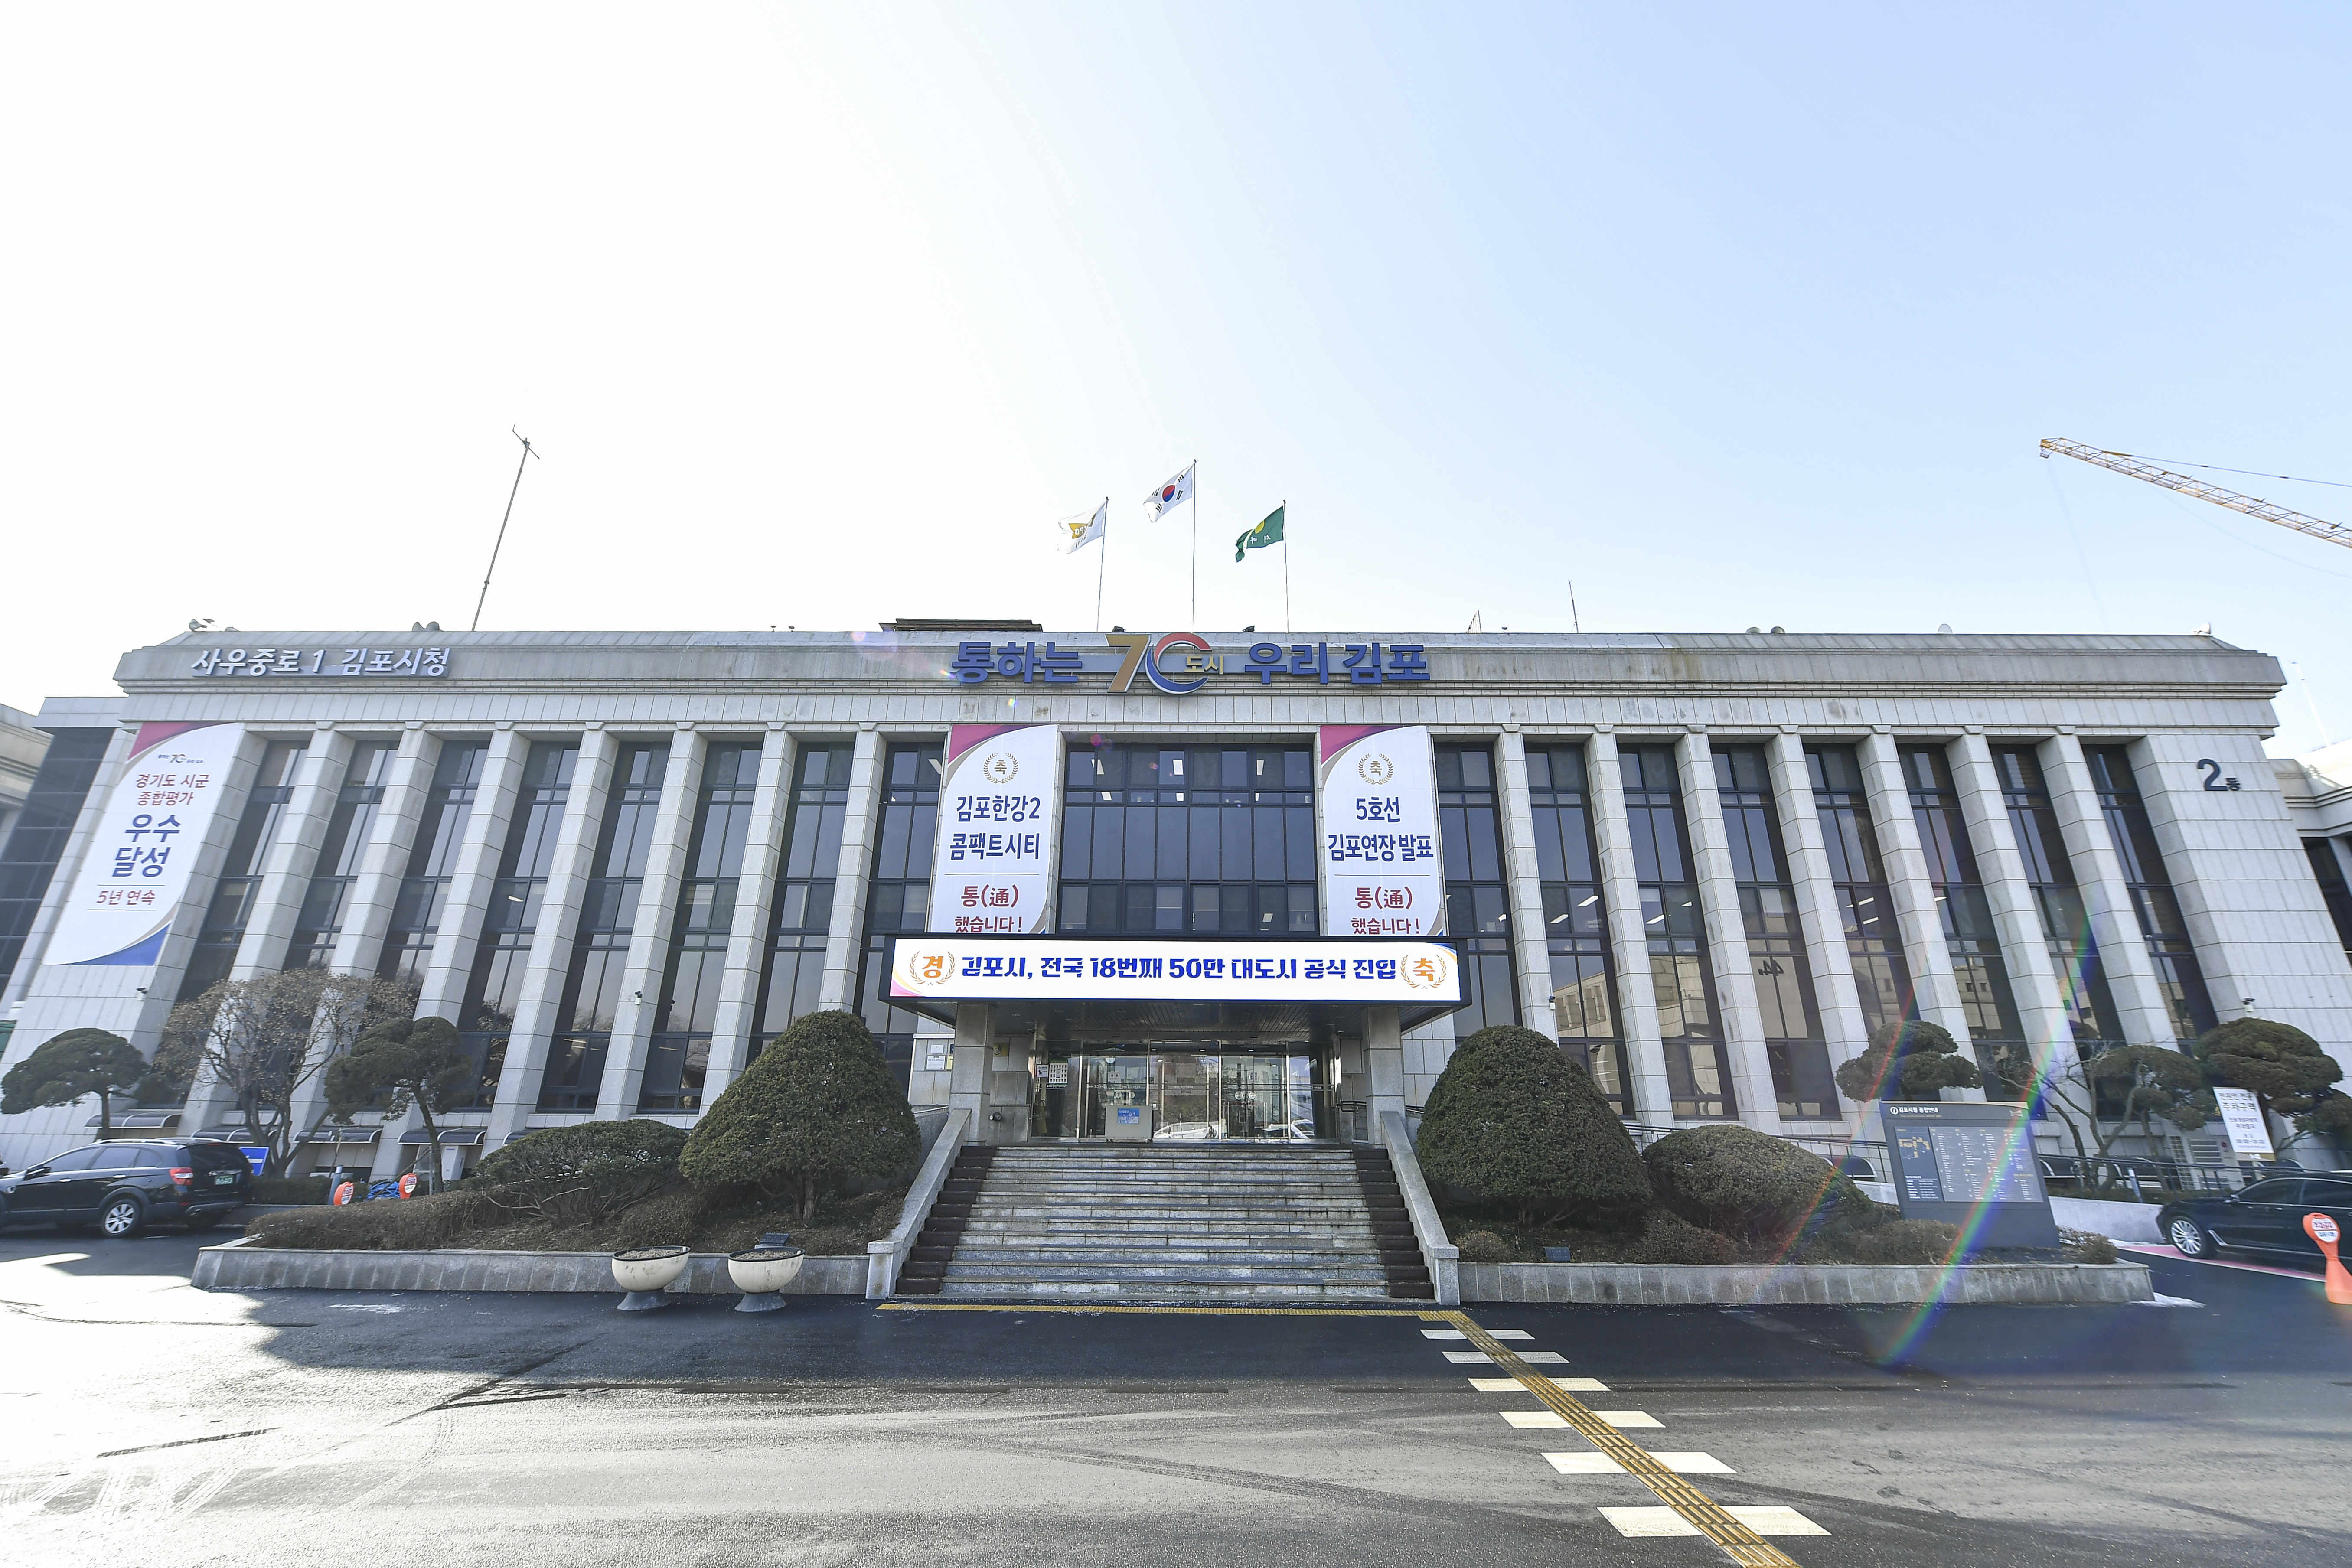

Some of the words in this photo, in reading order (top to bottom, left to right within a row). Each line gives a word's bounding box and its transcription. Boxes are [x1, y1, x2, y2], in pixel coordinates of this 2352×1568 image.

[191, 648, 303, 676] 사우중로
[311, 649, 326, 673] 1
[342, 647, 450, 677] 김포시청
[952, 641, 1082, 684] 통하는
[1184, 655, 1224, 675] 도시
[1245, 642, 1328, 684] 우리
[1343, 642, 1430, 684] 김포
[136, 774, 176, 788] 경기도
[180, 774, 209, 788] 시군
[994, 760, 1008, 775] 축
[1369, 761, 1383, 776] 축
[138, 791, 194, 806] 종합평가
[956, 795, 1041, 822] 김포한강2
[1356, 796, 1401, 823] 5호선
[124, 814, 181, 842] 우수
[949, 832, 1040, 860] 콤팩트시티
[1328, 834, 1396, 861] 김포연장
[1398, 834, 1434, 861] 발표
[111, 847, 172, 877] 달성
[96, 890, 123, 905] 5년
[126, 890, 156, 905] 연속
[961, 884, 1019, 908] 통(通)
[1354, 886, 1413, 910] 통(通)
[923, 955, 944, 978] 경
[962, 956, 1033, 980] 김포시,
[1041, 957, 1083, 978] 전국
[1090, 957, 1163, 978] 18번째
[1168, 958, 1226, 979] 50만
[1231, 958, 1297, 979] 대도시
[1304, 958, 1346, 980] 공식
[1352, 959, 1396, 980] 진입
[1412, 958, 1435, 982] 축
